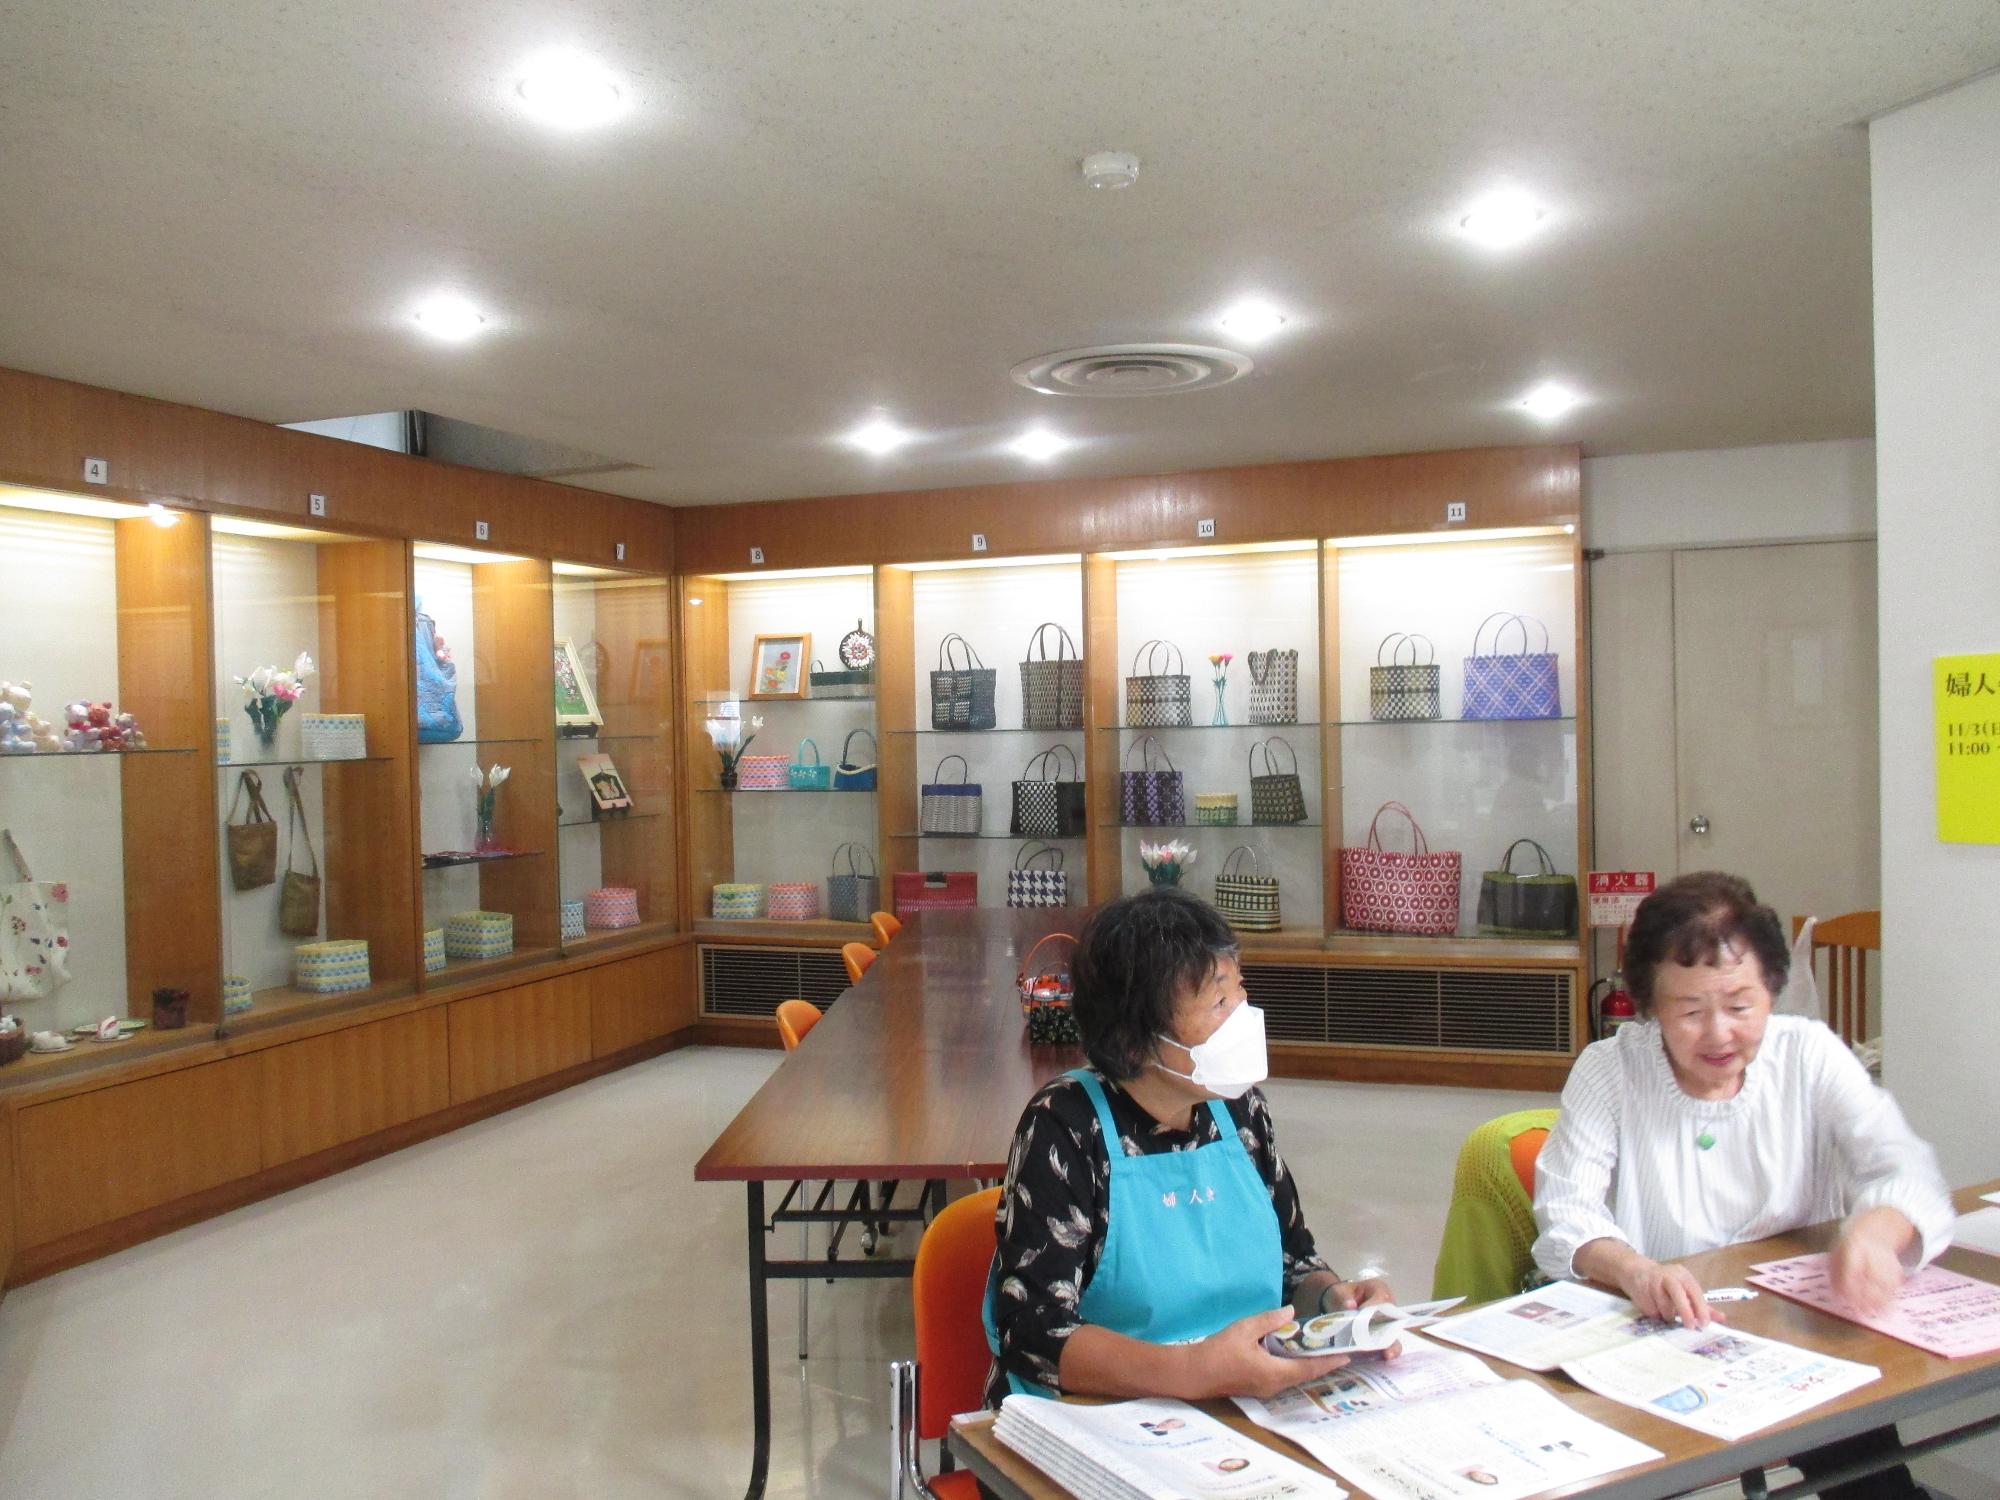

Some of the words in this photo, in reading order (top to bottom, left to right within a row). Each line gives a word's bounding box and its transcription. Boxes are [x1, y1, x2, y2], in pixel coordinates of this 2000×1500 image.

[90, 463, 100, 477] 4
[1450, 507, 1463, 517] 11
[1202, 525, 1212, 533] 10
[1945, 672, 2000, 697] 婦人
